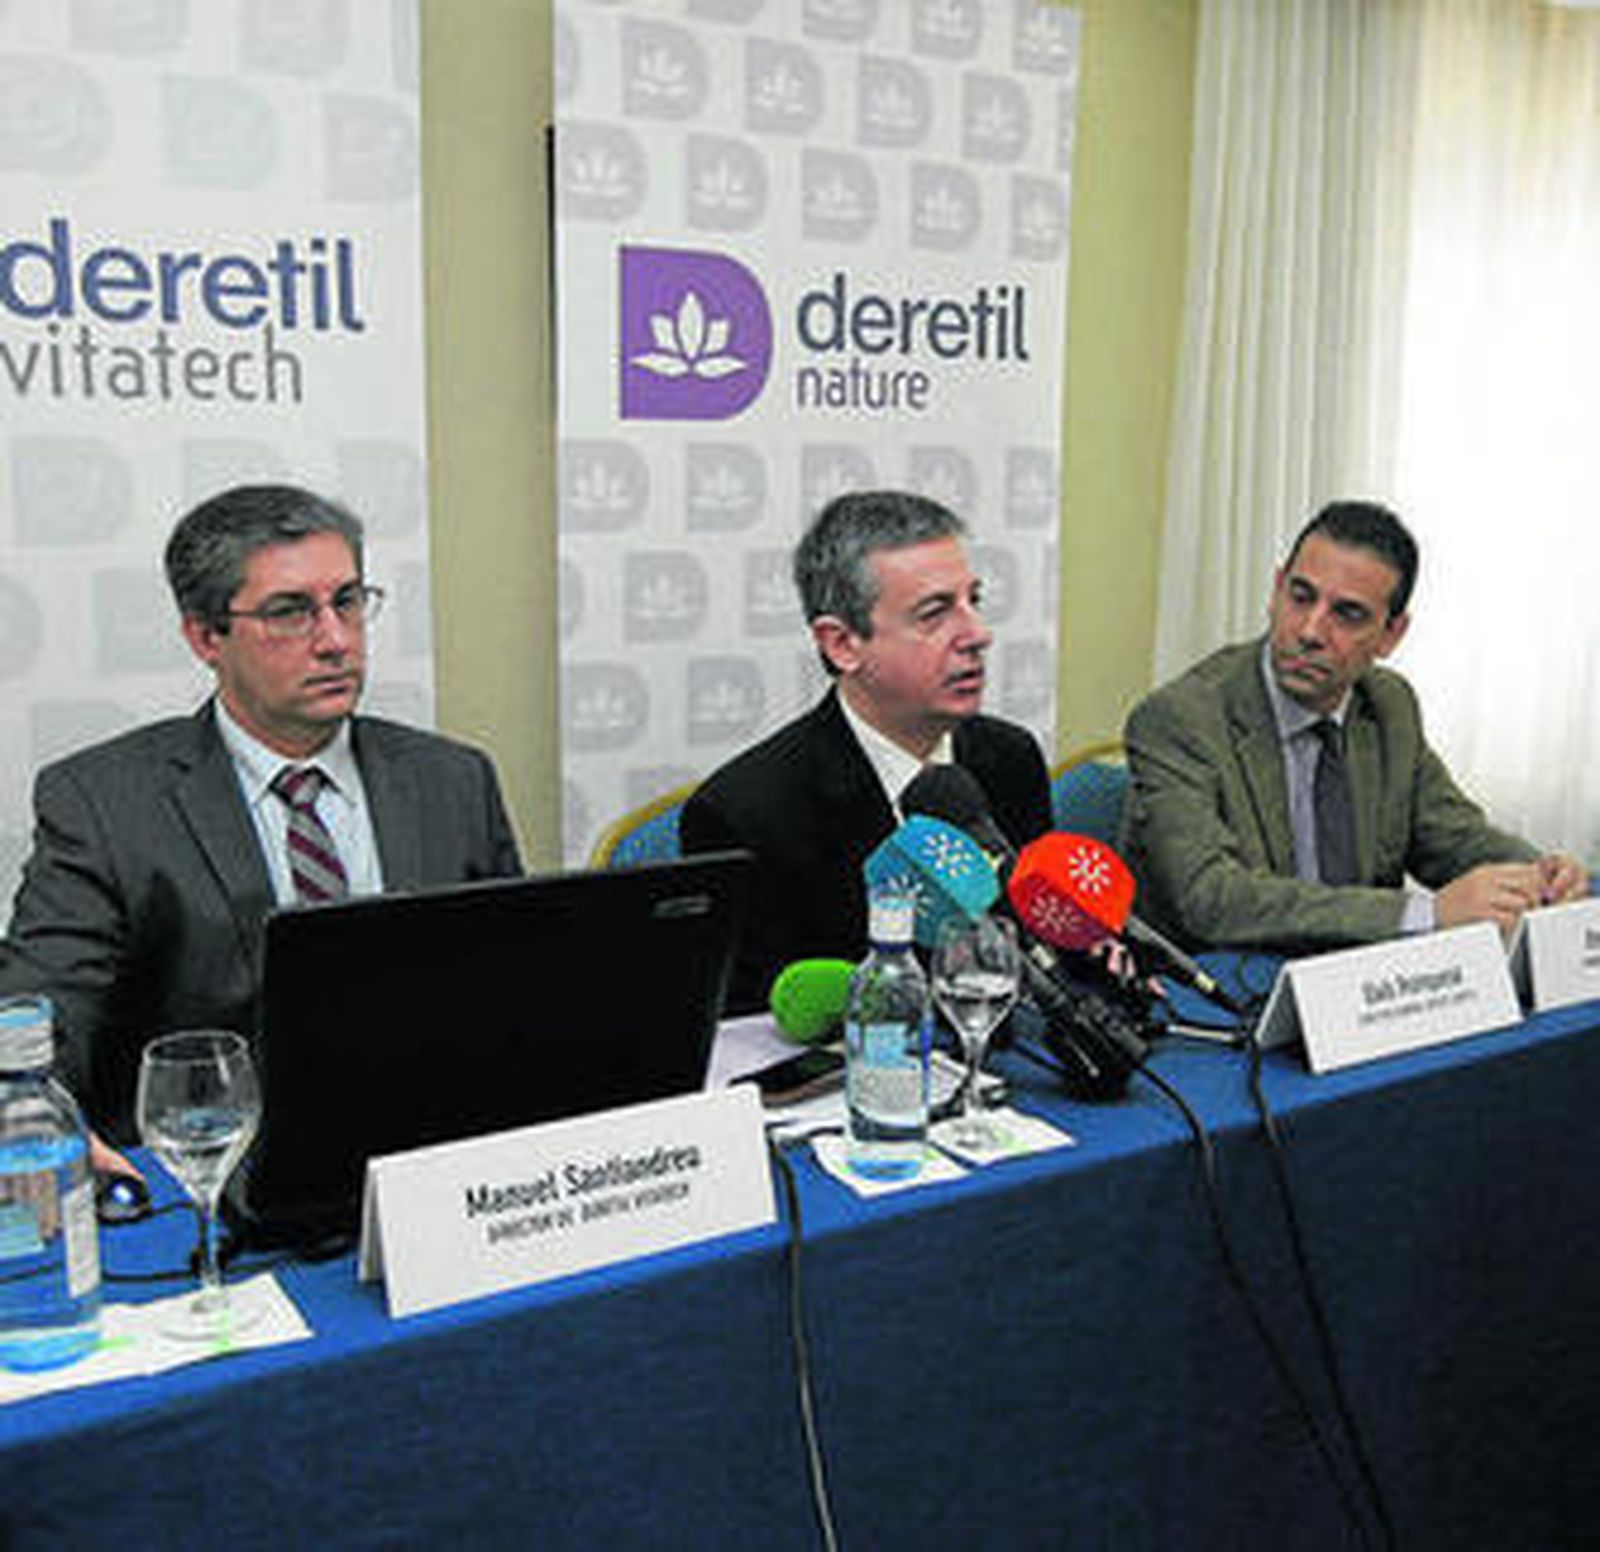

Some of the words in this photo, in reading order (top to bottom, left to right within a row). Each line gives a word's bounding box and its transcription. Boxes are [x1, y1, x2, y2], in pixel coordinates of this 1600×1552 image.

[0, 219, 364, 332] deretil
[796, 273, 1029, 361] deretil
[0, 322, 303, 403] vitatech
[796, 358, 930, 410] nature
[465, 1170, 559, 1219] Manuel
